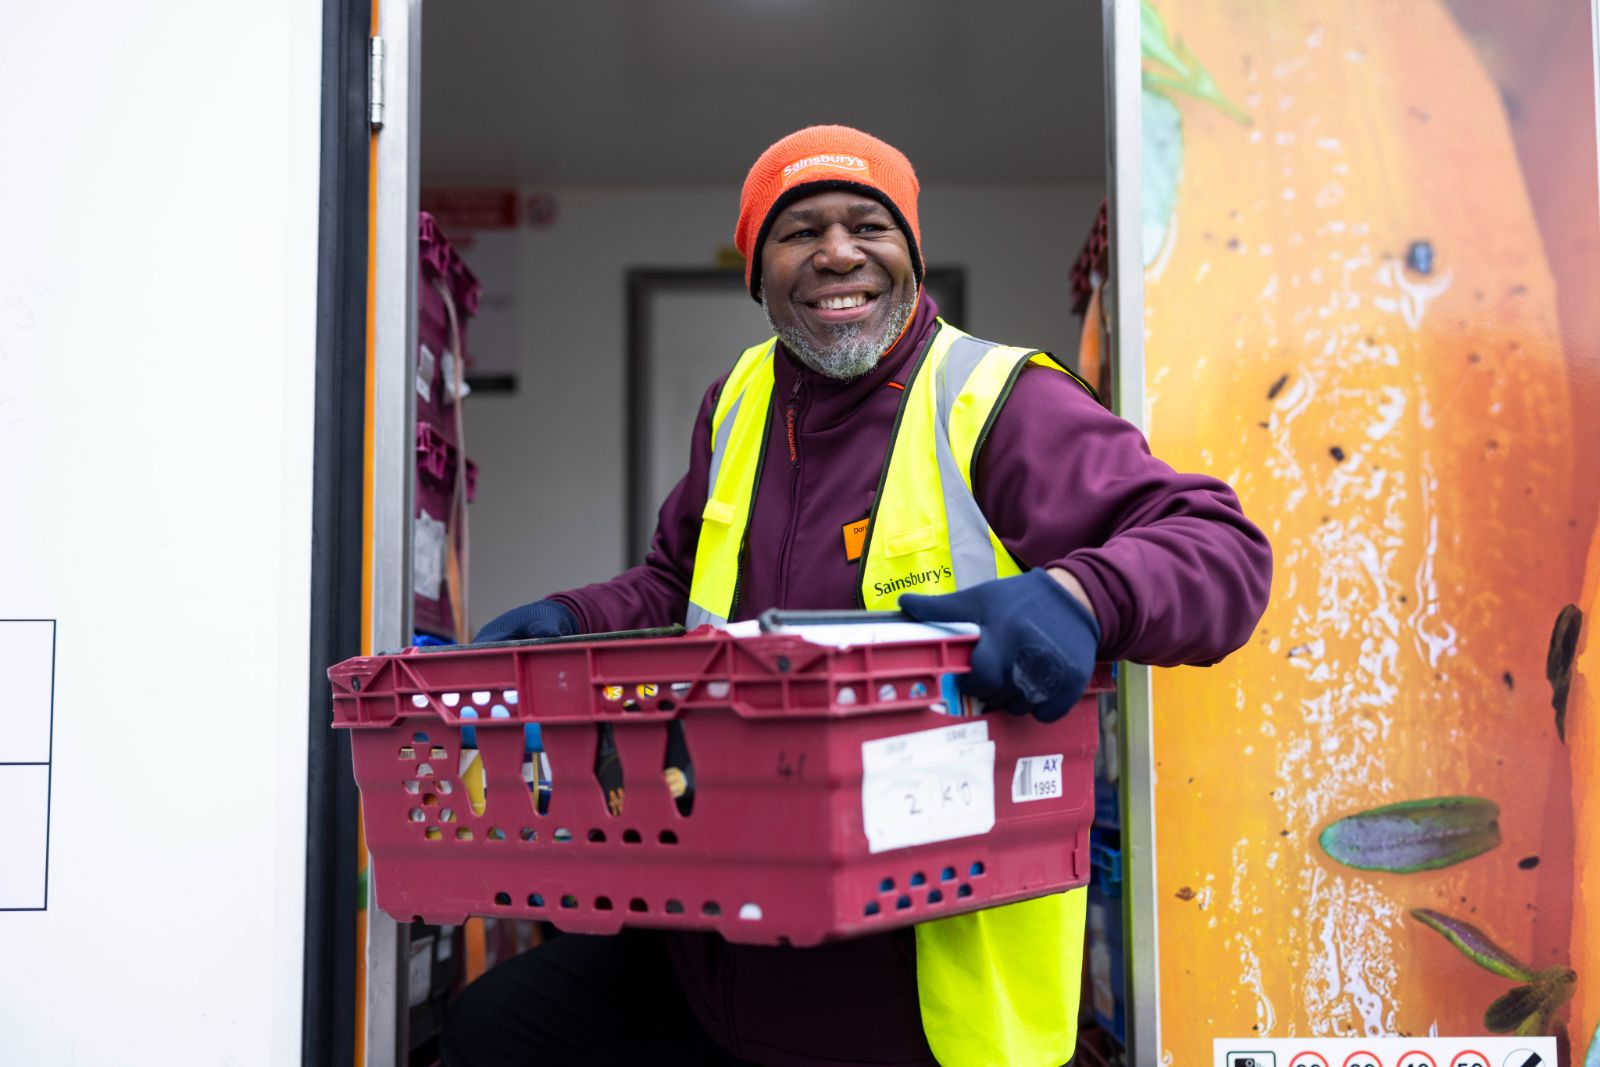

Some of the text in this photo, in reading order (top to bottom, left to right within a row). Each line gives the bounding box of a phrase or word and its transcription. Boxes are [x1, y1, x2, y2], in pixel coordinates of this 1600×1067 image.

[783, 154, 864, 176] Sainsbury's
[874, 565, 952, 597] Sainsbury's
[1043, 758, 1057, 772] AX
[1033, 780, 1057, 796] 1995
[904, 793, 922, 815] 2
